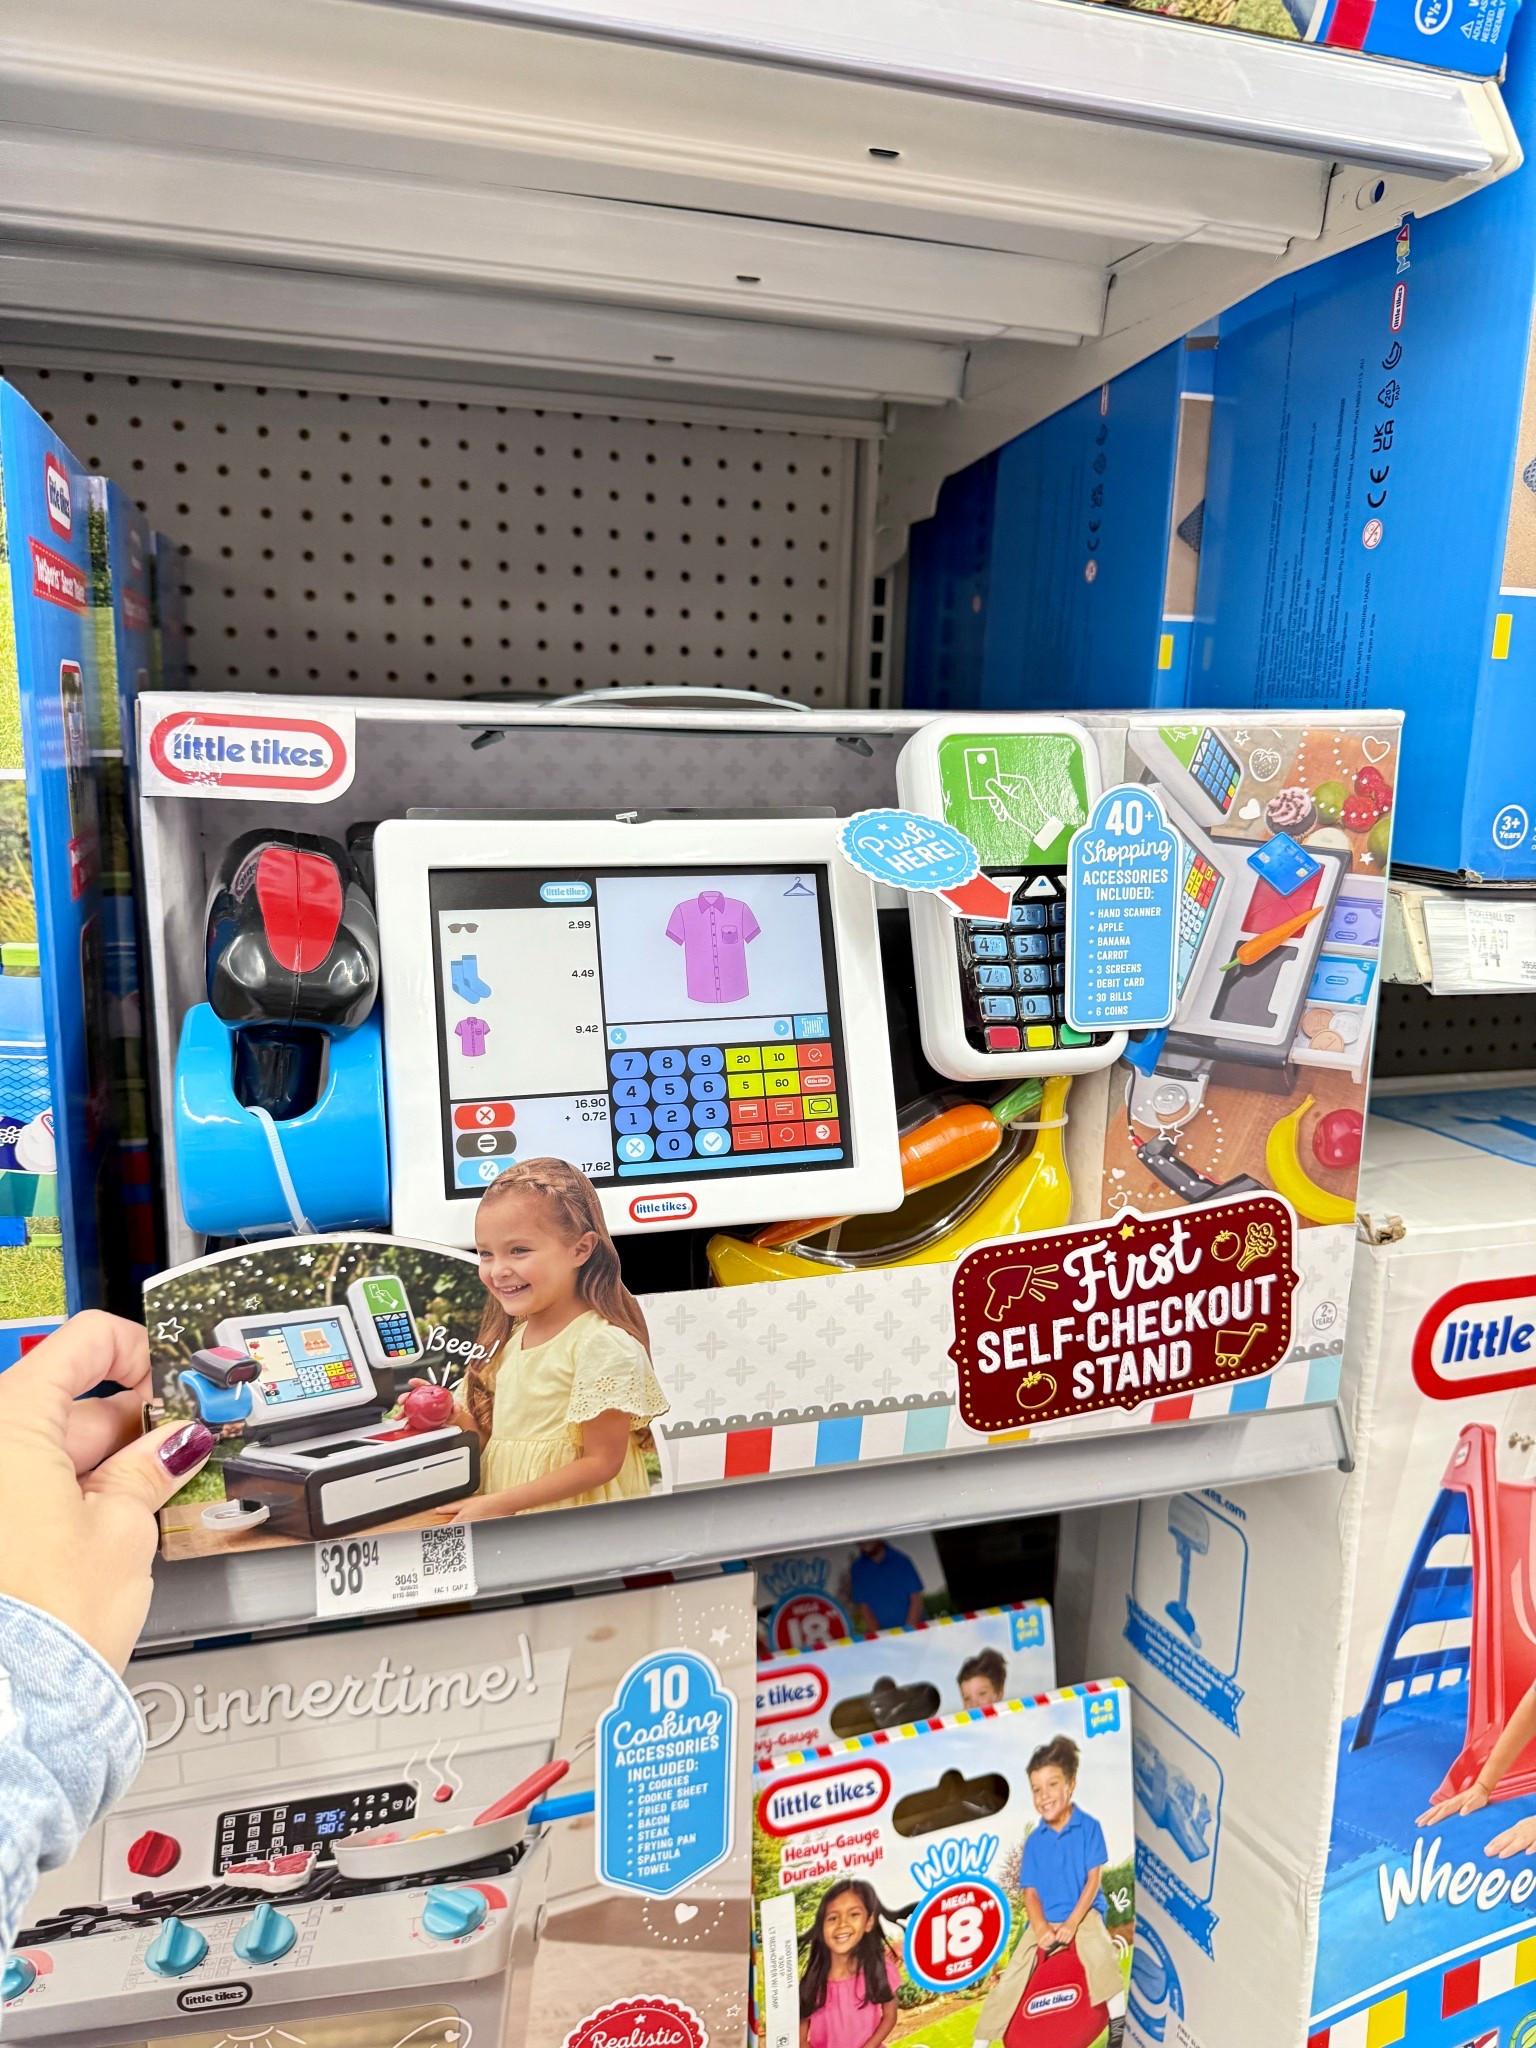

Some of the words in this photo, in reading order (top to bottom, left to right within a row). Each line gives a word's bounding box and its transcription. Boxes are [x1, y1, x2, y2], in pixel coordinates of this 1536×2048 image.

[1472, 13, 1485, 41] ADULT
[1393, 308, 1401, 328] little
[1385, 390, 1391, 401] 20
[1372, 422, 1385, 453] UK
[1383, 419, 1394, 450] CA
[1367, 465, 1390, 509] CE
[1353, 665, 1362, 690] SMALL
[1359, 604, 1369, 639] CHOKING
[174, 732, 245, 764] little
[250, 738, 324, 769] tikes
[1105, 799, 1155, 837] 40+
[1501, 815, 1521, 831] 3+
[857, 819, 936, 859] Push
[1499, 830, 1521, 839] Years
[884, 840, 958, 876] HERE!
[1082, 838, 1172, 868] Shopping
[1082, 869, 1169, 886] ACCESSORIES
[546, 887, 565, 896] little
[566, 887, 586, 896] tikes
[1096, 886, 1155, 902] INCLUDED:
[1014, 907, 1025, 923] 2
[1097, 908, 1121, 918] HAND
[1123, 907, 1162, 917] SCANNER
[1345, 914, 1357, 923] 20
[1504, 913, 1515, 923] SET
[568, 921, 591, 930] 2.99
[1097, 922, 1124, 932] APPLE
[979, 937, 989, 953] 4
[1020, 938, 1029, 953] 5
[1097, 936, 1131, 946] BANANA
[1097, 950, 1128, 960] CARROT
[571, 969, 595, 978] 4.49
[1096, 965, 1102, 975] 3
[1105, 963, 1142, 974] SCREENS
[1362, 962, 1370, 971] 5
[983, 967, 993, 984] 7
[1023, 967, 1033, 983] 8
[1096, 978, 1120, 988] DEBIT
[1122, 977, 1145, 987] CARD
[1096, 993, 1107, 1002] 30
[1110, 991, 1132, 1001] BILLS
[988, 998, 997, 1013] F
[1026, 999, 1036, 1014] 0
[1096, 1007, 1102, 1016] 6
[1105, 1006, 1128, 1015] COINS
[575, 1025, 599, 1034] 9.42
[623, 1059, 634, 1072] 7
[662, 1056, 673, 1069] 8
[700, 1054, 712, 1067] 9
[736, 1054, 751, 1064] 20
[773, 1052, 785, 1062] 10
[626, 1085, 637, 1098] 4
[664, 1083, 675, 1096] 5
[703, 1080, 714, 1093] 6
[742, 1080, 750, 1090] 5
[775, 1078, 789, 1088] 60
[575, 1098, 607, 1109] 16.90
[582, 1112, 607, 1123] 0.72
[629, 1112, 637, 1126] 1
[667, 1110, 678, 1123] 2
[705, 1107, 716, 1120] 3
[668, 1138, 680, 1151] 0
[582, 1161, 612, 1173] 17.62
[636, 1202, 661, 1214] little
[661, 1201, 687, 1212] tikes
[1063, 1219, 1202, 1313] First
[1319, 1304, 1333, 1318] 2+
[976, 1273, 1278, 1375] SELF-CHECKOUT
[1314, 1315, 1334, 1327] YEARS
[425, 1325, 500, 1364] Beep!
[1441, 1315, 1536, 1364] little
[1071, 1339, 1192, 1400] STAND
[394, 1573, 418, 1586] 3043
[763, 1557, 828, 1597] WOW!
[434, 1586, 446, 1594] FAC
[452, 1584, 464, 1592] CAP
[1016, 1615, 1038, 1630] 4-8
[1017, 1627, 1040, 1642] years
[132, 1633, 539, 1750] Dinnertime!
[643, 1664, 690, 1714] 10
[768, 1683, 815, 1706] tikes
[1090, 1699, 1113, 1715] 4-8
[1091, 1712, 1114, 1729] years
[612, 1710, 722, 1750] Cooking
[614, 1734, 720, 1768] ACCESSORIES
[627, 1758, 699, 1784] INCLUDED:
[638, 1782, 645, 1793] 3
[648, 1775, 690, 1792] COOKIES
[353, 1797, 360, 1807] 1
[366, 1794, 375, 1804] 2
[381, 1792, 390, 1802] 3
[637, 1791, 673, 1805] COOKIE
[677, 1783, 709, 1797] SHEET
[773, 1793, 822, 1820] little
[826, 1779, 876, 1806] tikes
[351, 1812, 359, 1822] 4
[364, 1810, 373, 1819] 5
[379, 1808, 388, 1818] 6
[637, 1804, 667, 1818] FRIED
[670, 1798, 690, 1811] EGG
[637, 1815, 671, 1829] BACON
[637, 1827, 670, 1841] STEAK
[637, 1838, 674, 1854] FRYING
[677, 1833, 697, 1846] PAN
[784, 1828, 880, 1863] Heavy-Gauge
[637, 1849, 681, 1866] SPATULA
[913, 1835, 1000, 1888] WOW!
[637, 1863, 671, 1877] TOWEL
[782, 1861, 838, 1886] Durable
[843, 1847, 884, 1872] Vinyl!
[940, 1891, 976, 1914] MEGA
[767, 1936, 779, 1978] REDHOPPER
[945, 1957, 973, 1977] SIZE
[184, 1992, 213, 2007] little
[215, 1989, 244, 2003] tikes
[770, 1989, 779, 2009] PUMP
[1030, 1997, 1051, 2011] little
[1052, 1992, 1075, 2006] tikes
[590, 2027, 684, 2048] Realistic
